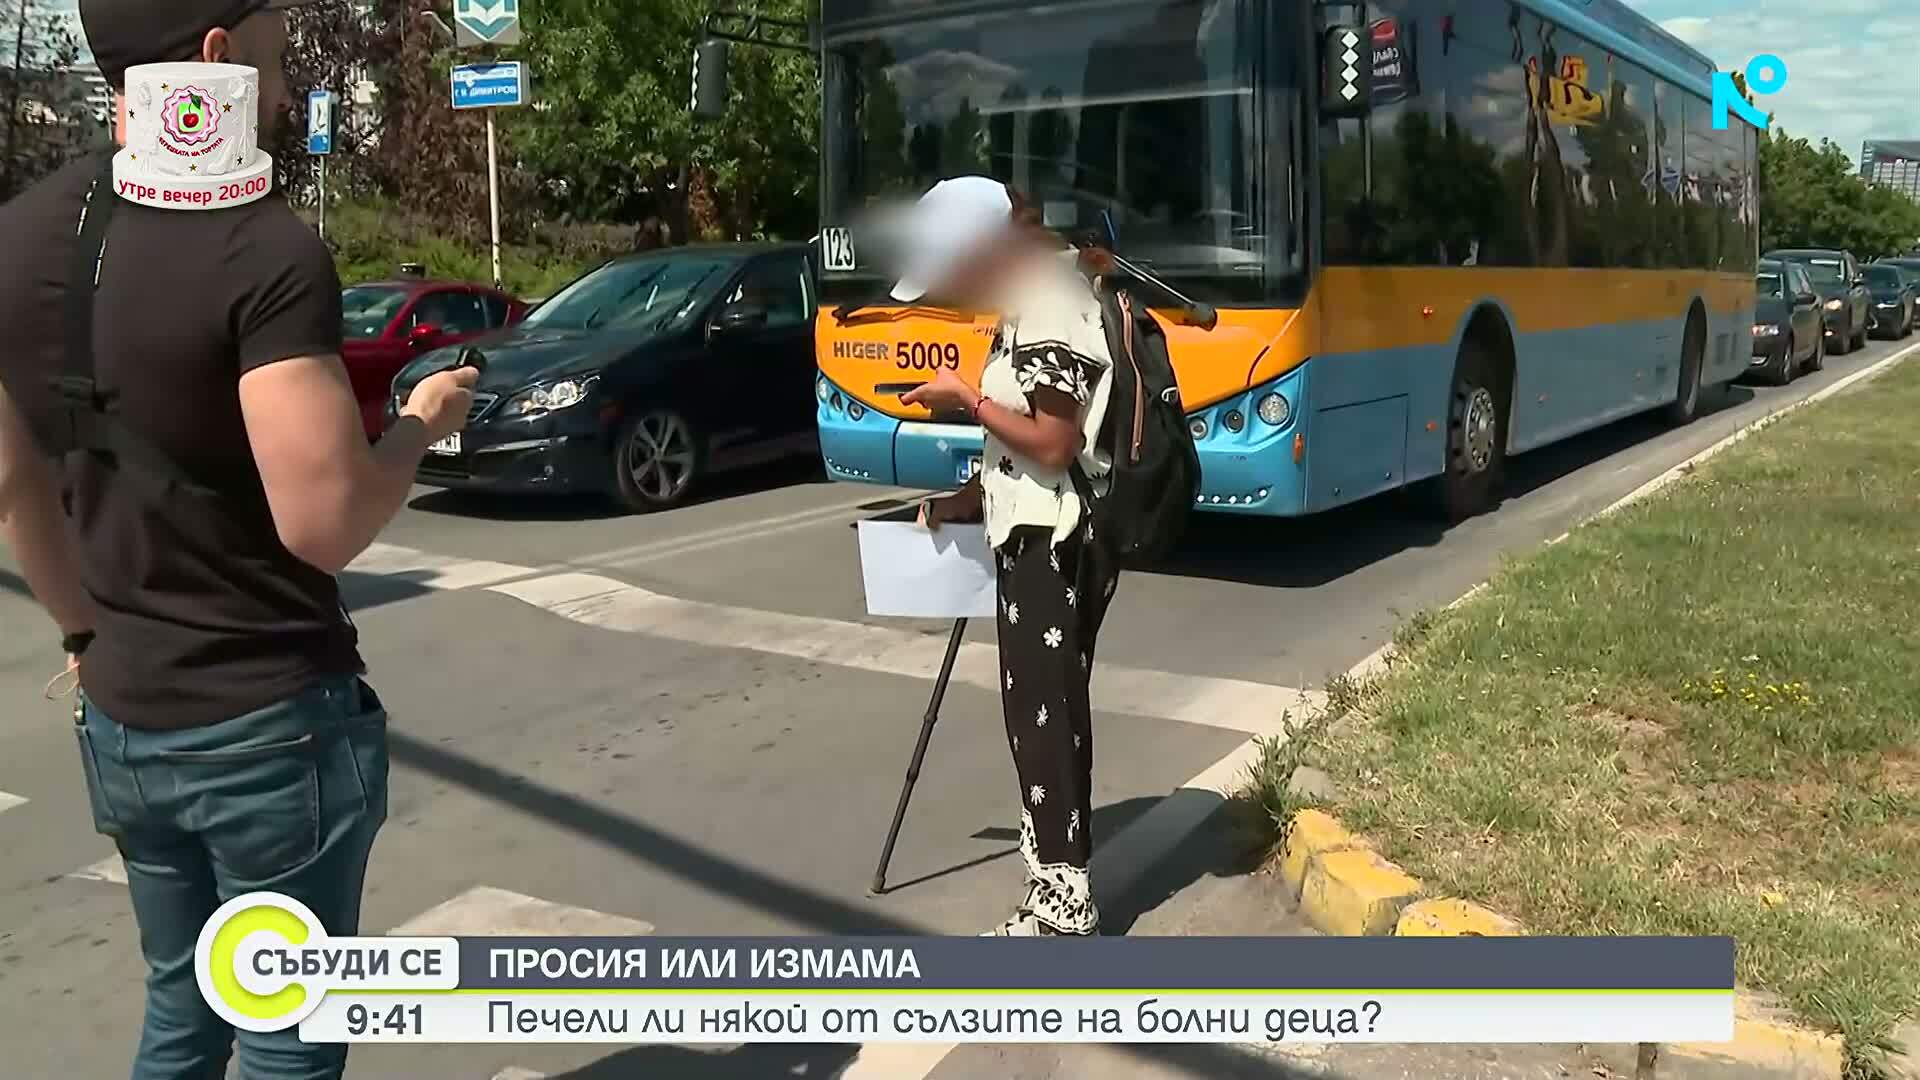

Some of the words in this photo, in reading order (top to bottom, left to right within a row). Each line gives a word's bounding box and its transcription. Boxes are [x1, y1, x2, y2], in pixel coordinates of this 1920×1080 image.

[826, 229, 853, 266] 123
[833, 341, 888, 360] HIGER
[896, 341, 959, 371] 5009
